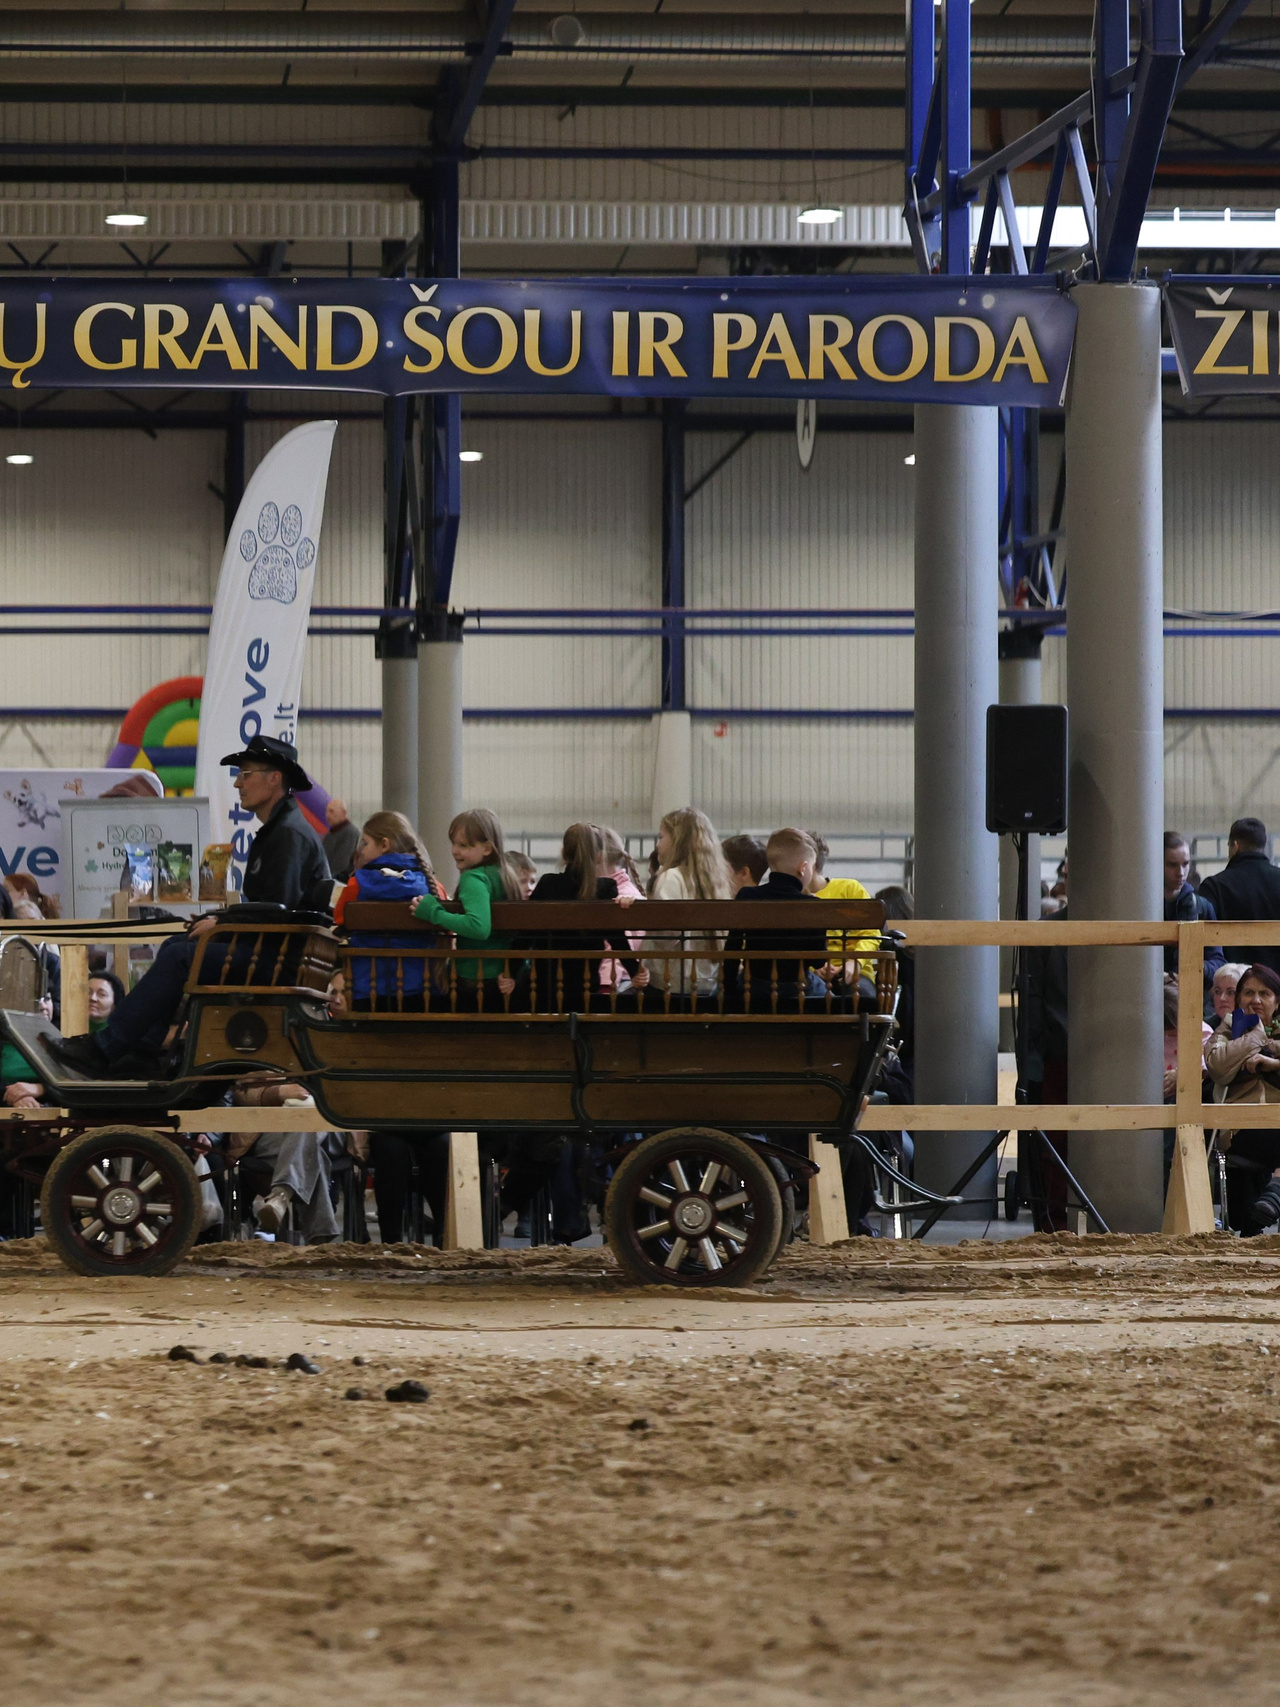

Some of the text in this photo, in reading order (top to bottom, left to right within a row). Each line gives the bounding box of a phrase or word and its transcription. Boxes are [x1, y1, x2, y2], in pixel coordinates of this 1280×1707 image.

[73, 301, 380, 371] GRAND
[402, 283, 583, 377] ŠOU
[611, 310, 689, 378] IR
[711, 312, 1050, 384] PARODA
[1193, 286, 1280, 375] ŽI
